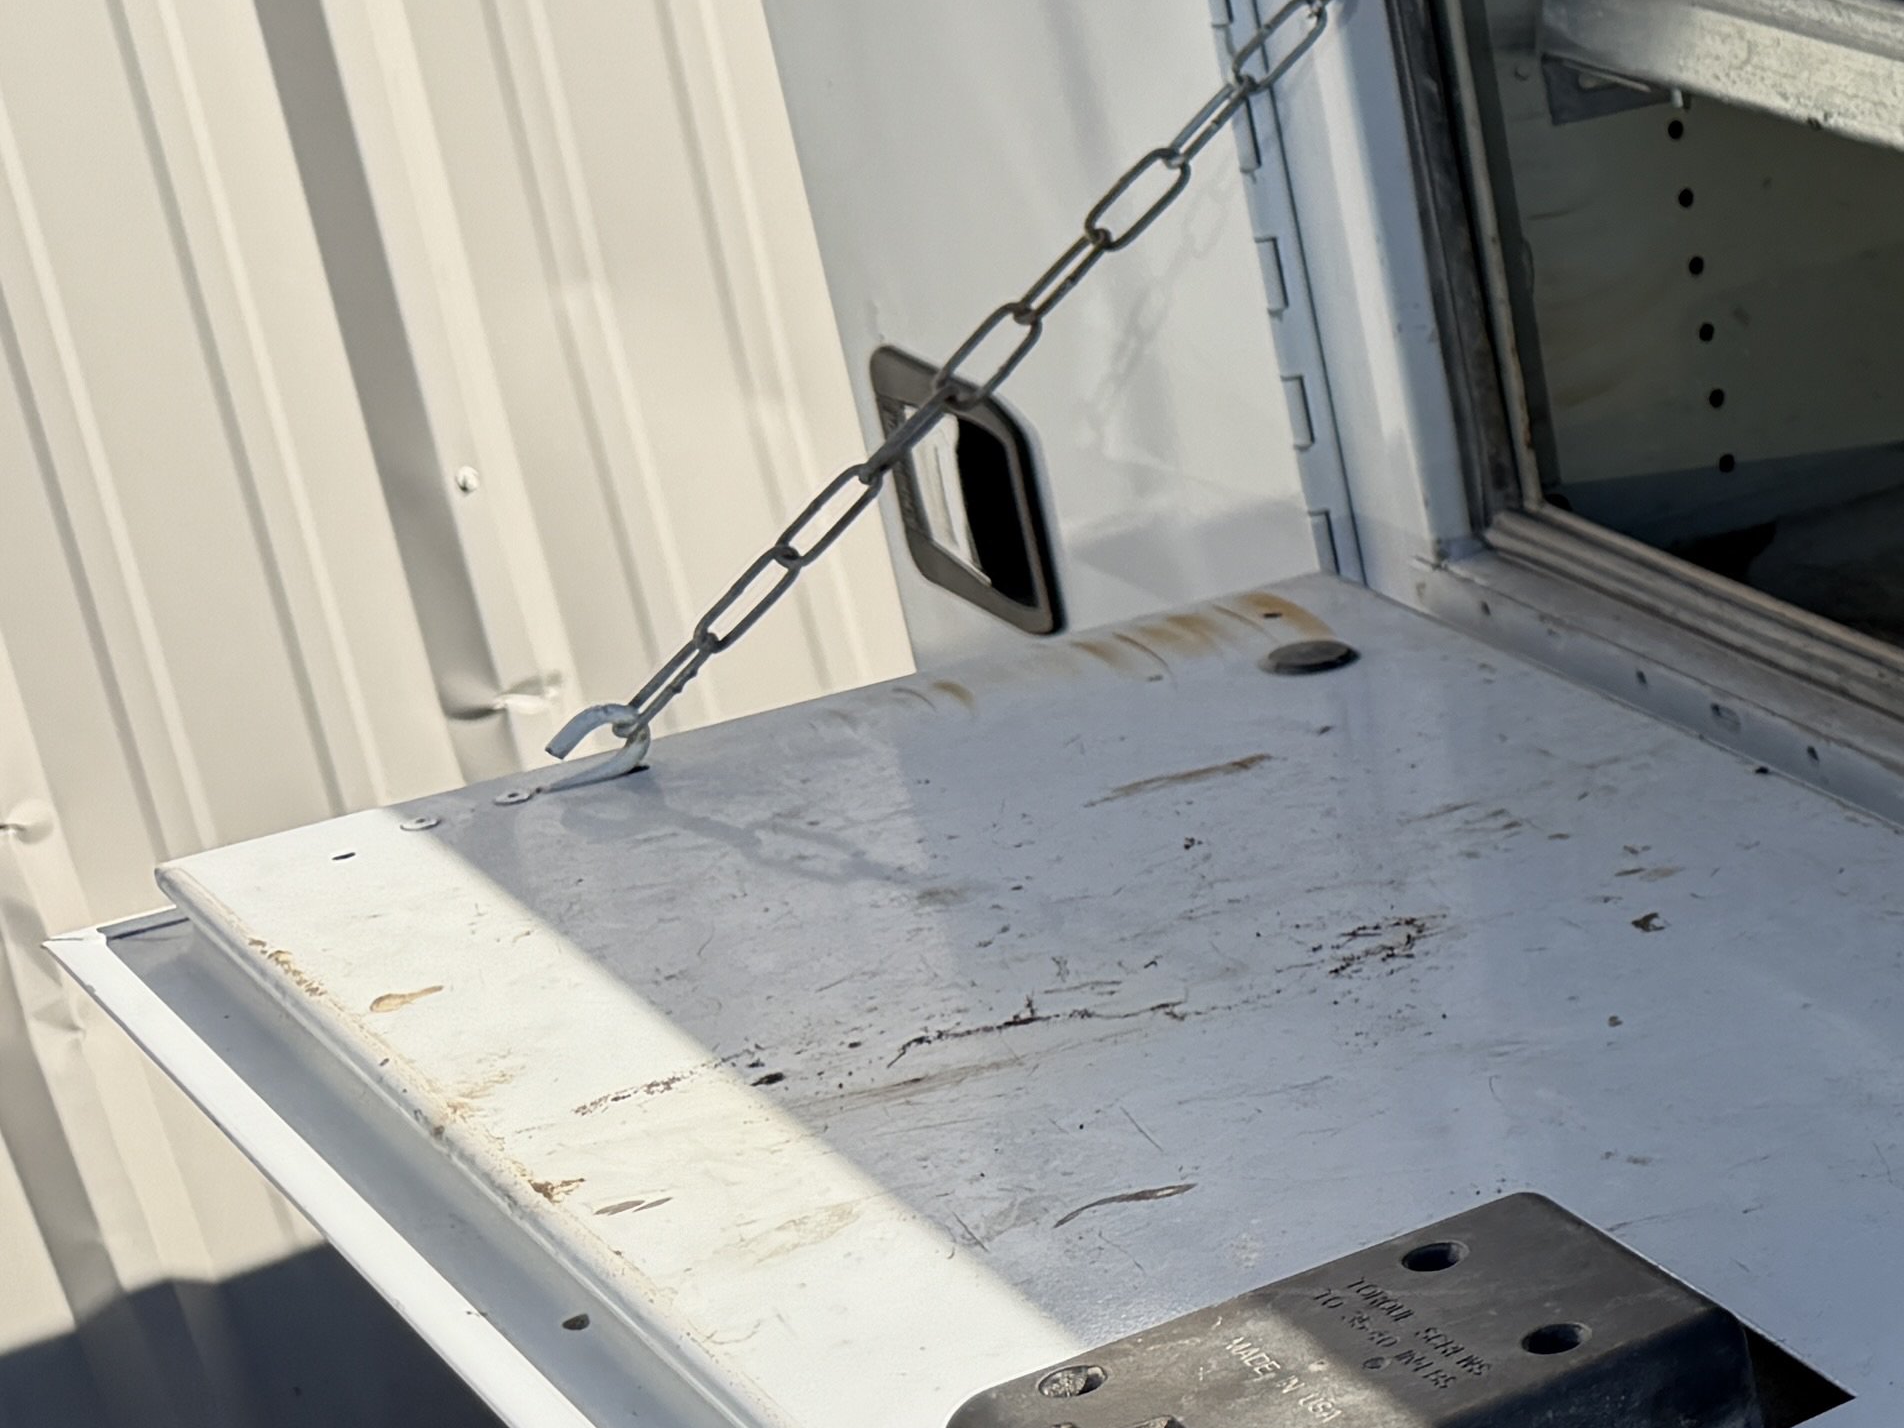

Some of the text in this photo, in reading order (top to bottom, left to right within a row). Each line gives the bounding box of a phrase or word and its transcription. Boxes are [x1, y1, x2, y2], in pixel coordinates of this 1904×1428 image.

[1311, 1287, 1345, 1309] TO
[1225, 1335, 1344, 1424] MADE IN USA
